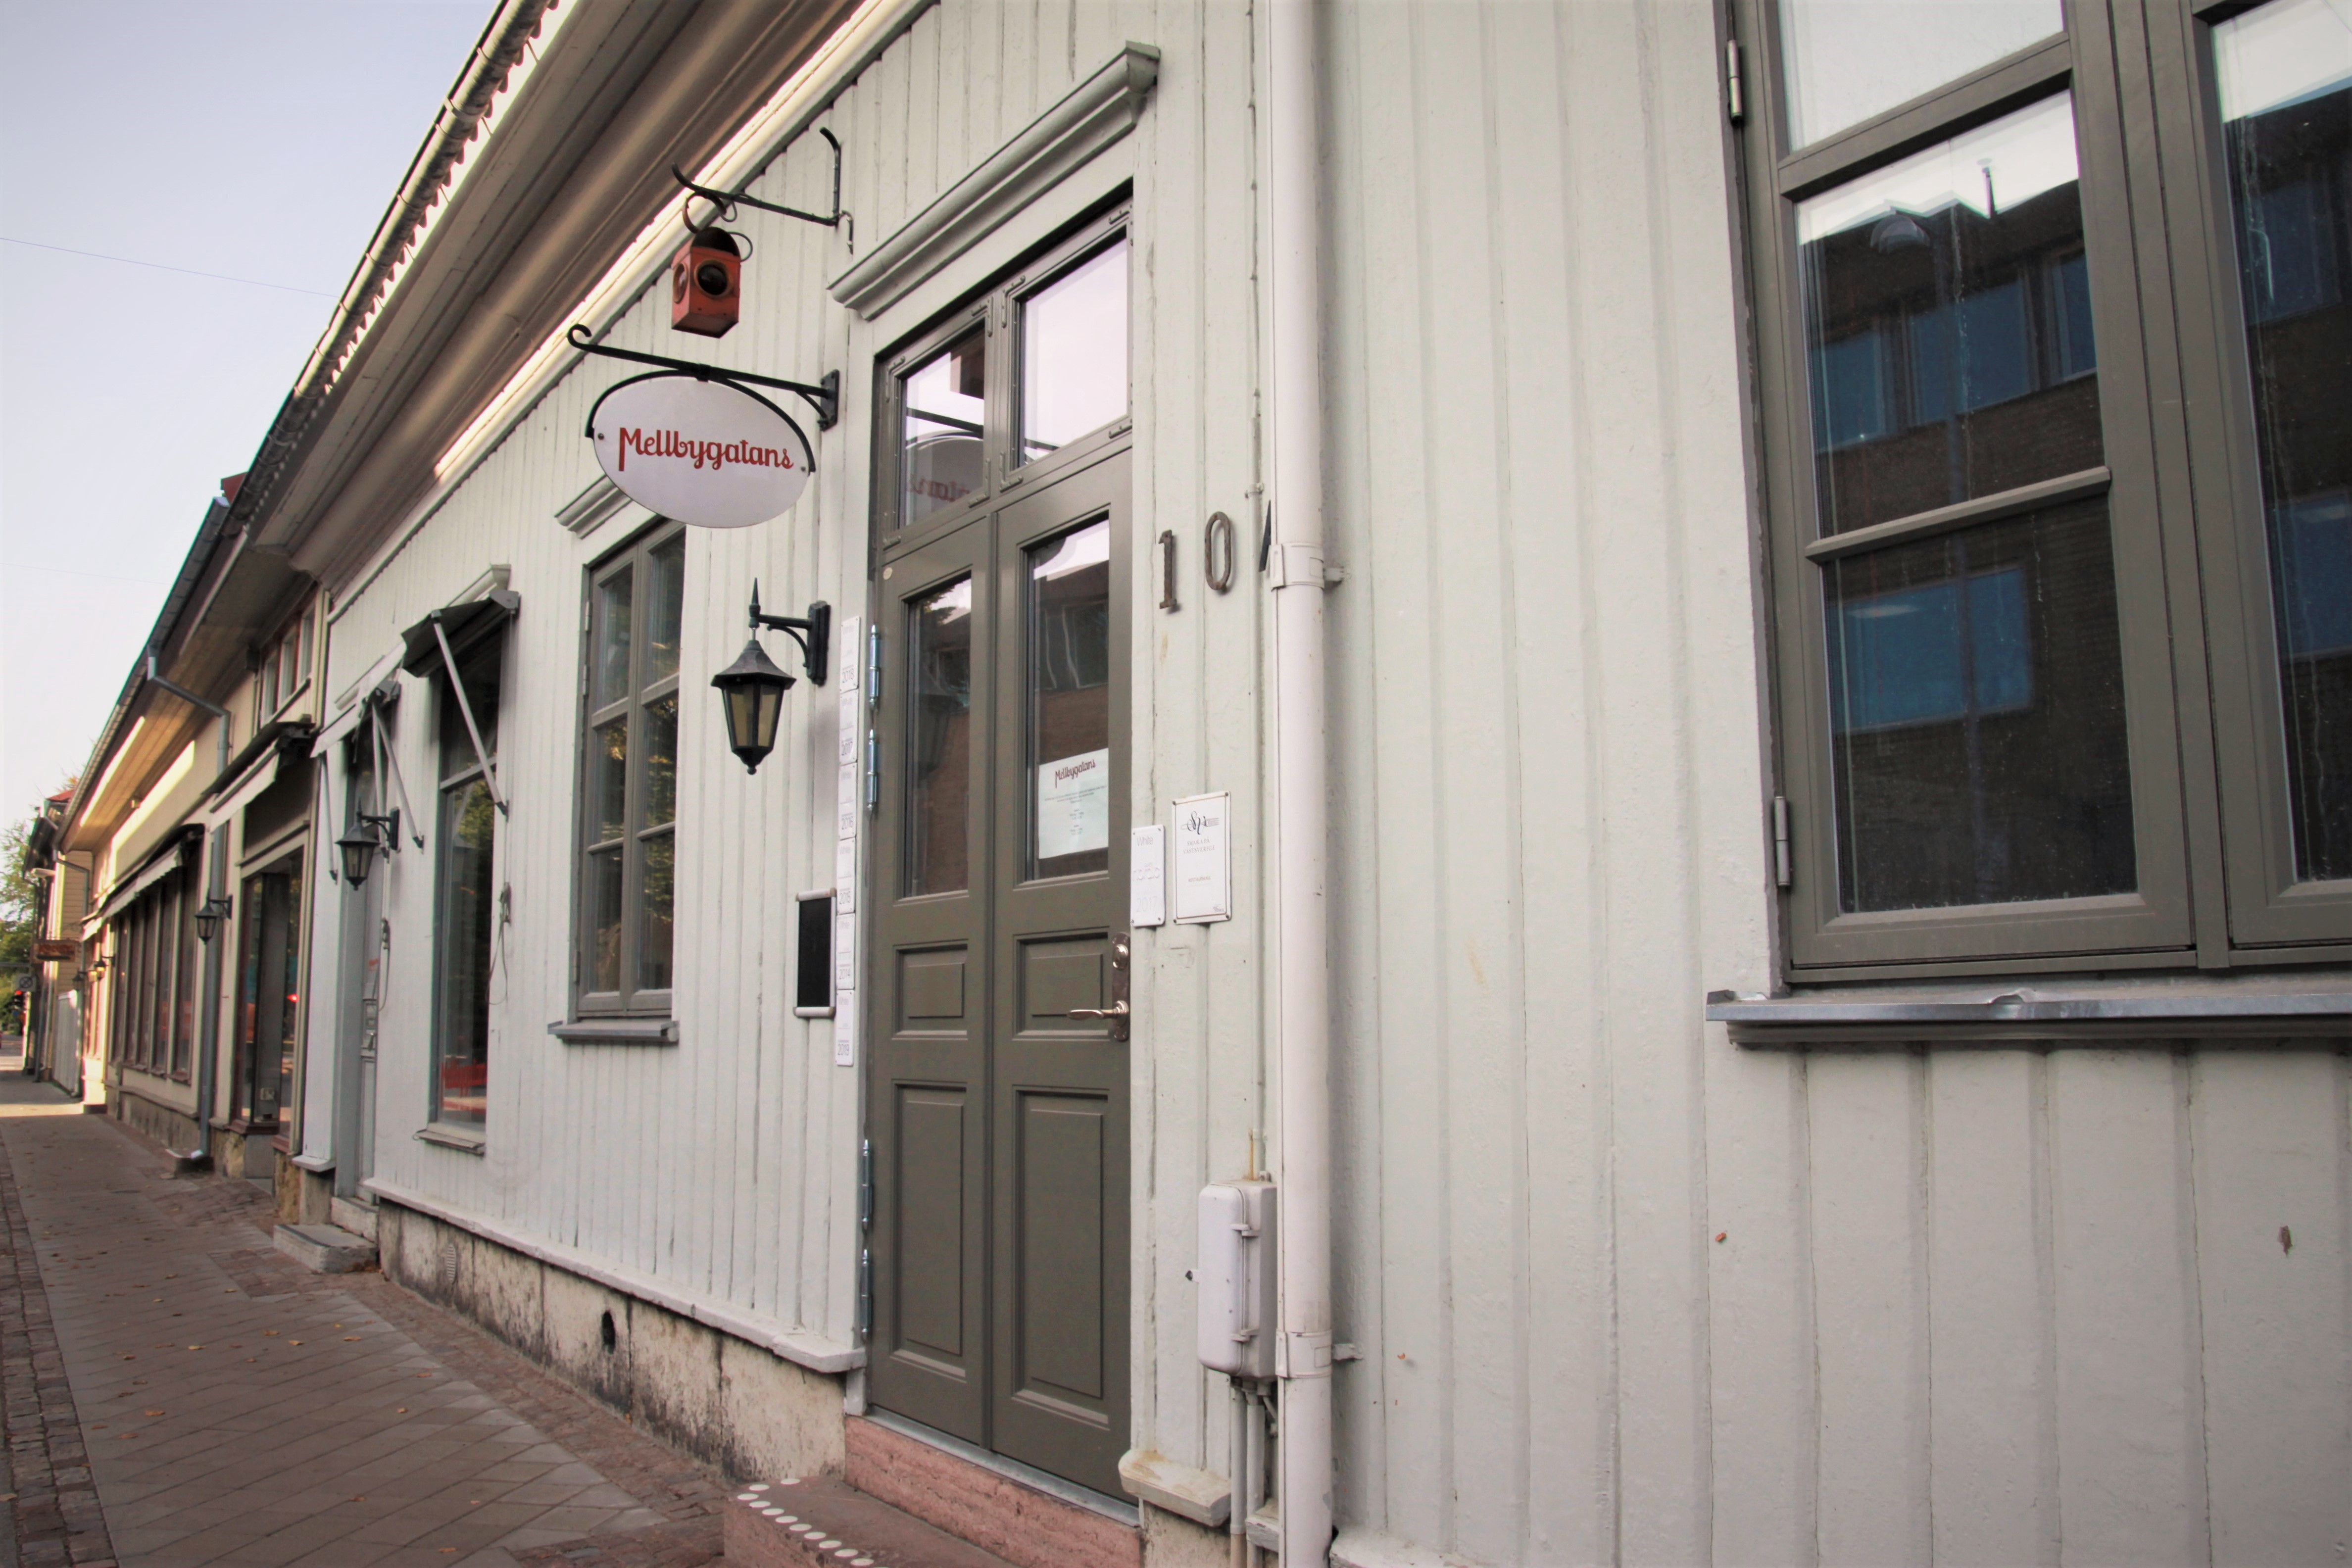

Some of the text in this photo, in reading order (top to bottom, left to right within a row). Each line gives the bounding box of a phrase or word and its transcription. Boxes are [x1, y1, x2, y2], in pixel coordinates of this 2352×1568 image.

[618, 427, 794, 472] Mellbygatans
[1158, 511, 1231, 609] 10
[842, 668, 854, 683] 2018
[841, 741, 853, 756] 2017
[1055, 759, 1096, 788] Mellbygatans
[841, 816, 853, 830] 2016
[1136, 836, 1154, 846] White
[839, 890, 851, 905] 2015
[1136, 895, 1157, 912] 2017
[839, 968, 850, 980] 2014
[837, 1043, 850, 1056] 2019
